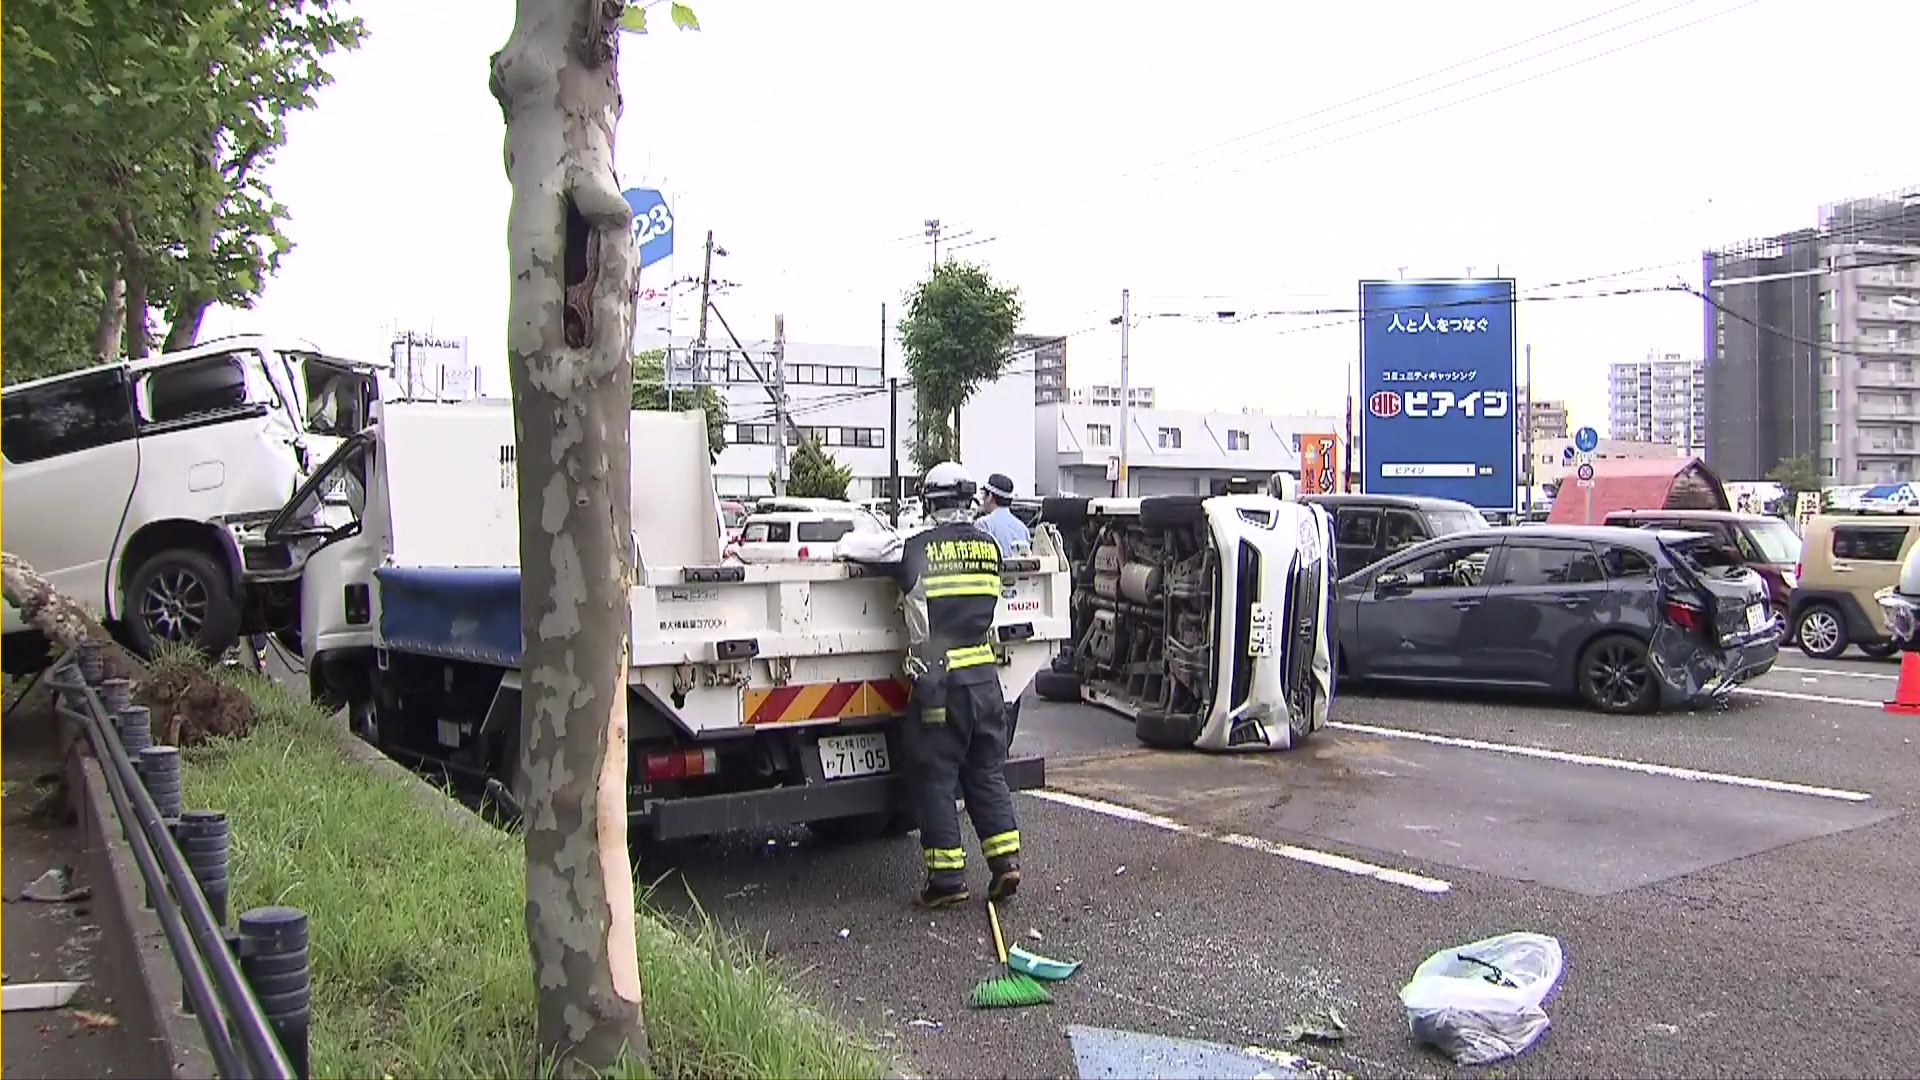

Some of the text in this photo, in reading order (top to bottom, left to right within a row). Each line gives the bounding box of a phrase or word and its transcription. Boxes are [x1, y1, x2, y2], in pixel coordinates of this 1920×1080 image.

[632, 203, 673, 247] 23
[1387, 311, 1489, 333] 人と人をつなぐ
[1382, 370, 1477, 381] コミュニティキャッシング
[1007, 601, 1039, 611] ISUZU
[1250, 615, 1266, 653] 31-75
[835, 747, 887, 774] 71-05
